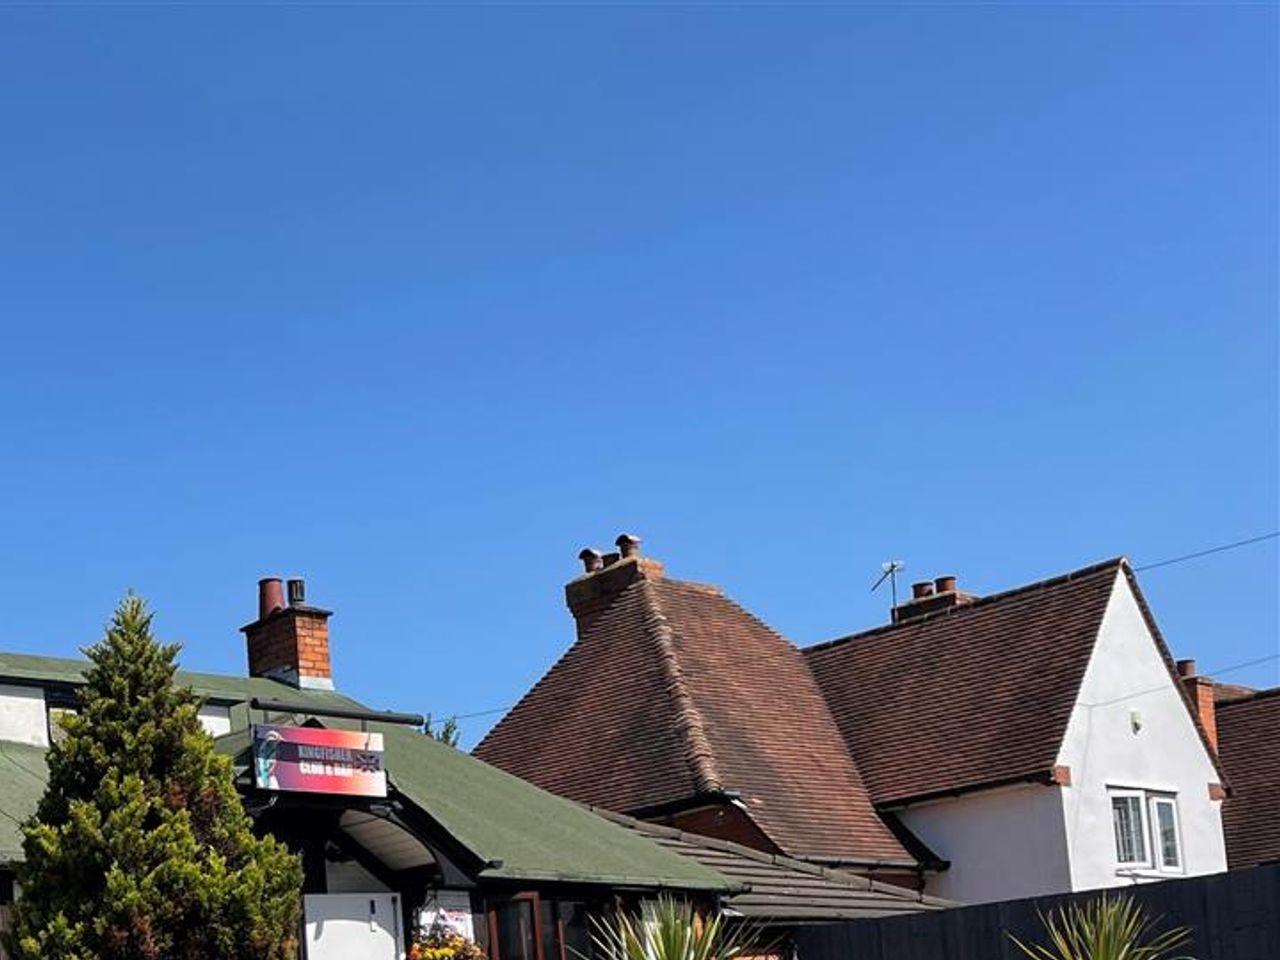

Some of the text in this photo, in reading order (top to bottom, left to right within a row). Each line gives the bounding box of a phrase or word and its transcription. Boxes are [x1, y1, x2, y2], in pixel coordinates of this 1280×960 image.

[298, 745, 353, 762] KINGFISHER
[299, 760, 354, 778] CLUB & BAR
